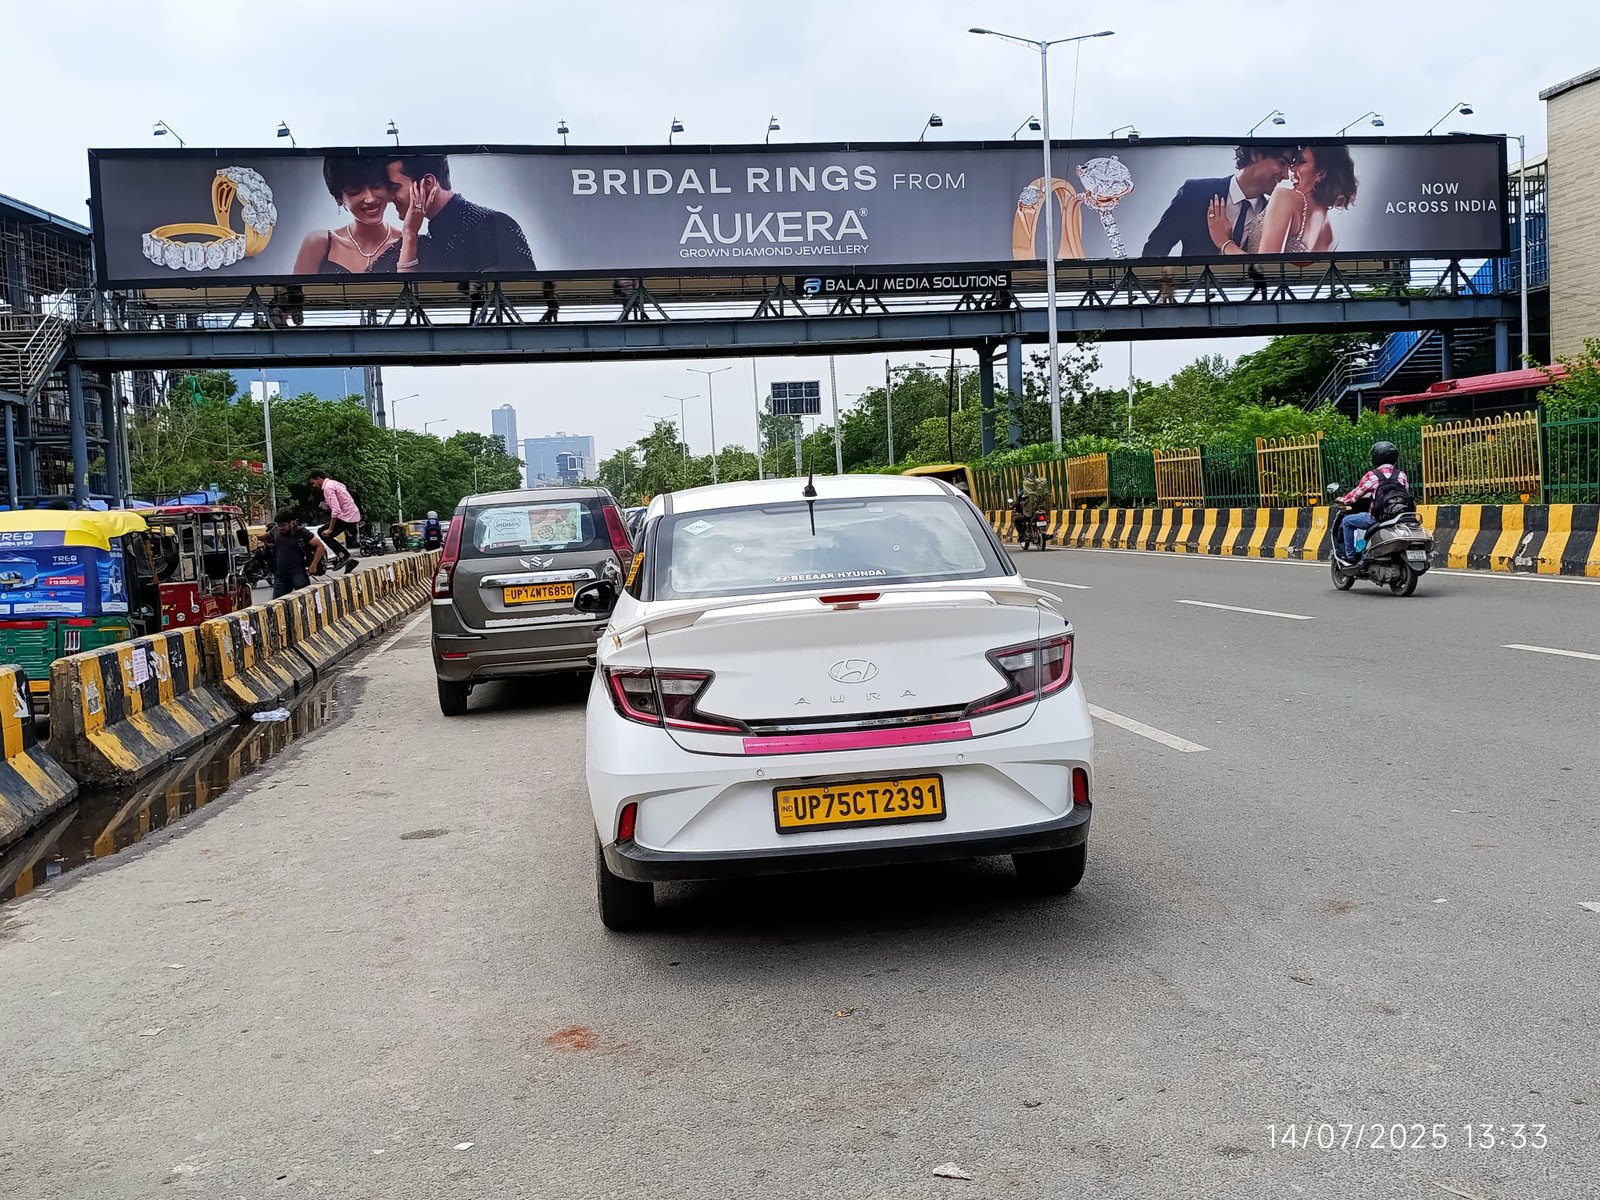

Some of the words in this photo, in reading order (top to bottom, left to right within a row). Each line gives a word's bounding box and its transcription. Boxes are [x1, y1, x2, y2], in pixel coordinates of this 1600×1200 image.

[571, 168, 731, 196] BRIDAL
[746, 165, 878, 193] RINGS
[892, 172, 966, 190] FROM
[1421, 182, 1459, 195] NOW
[1385, 200, 1449, 214] ACROSS
[1454, 199, 1497, 212] INDIA
[679, 248, 730, 259] GROWN
[732, 246, 793, 257] DIAMOND
[795, 244, 870, 256] JEWELLERY
[825, 278, 878, 291] BALAJI
[883, 277, 930, 290] MEDIA
[932, 275, 1007, 289] SOLUTIONS
[791, 572, 835, 581] BEEAAR
[837, 569, 887, 578] HYUNDAI
[510, 585, 573, 600] UP14NT6850
[794, 689, 917, 706] AURA
[780, 804, 794, 814] IND
[793, 784, 938, 821] UP75CT2391
